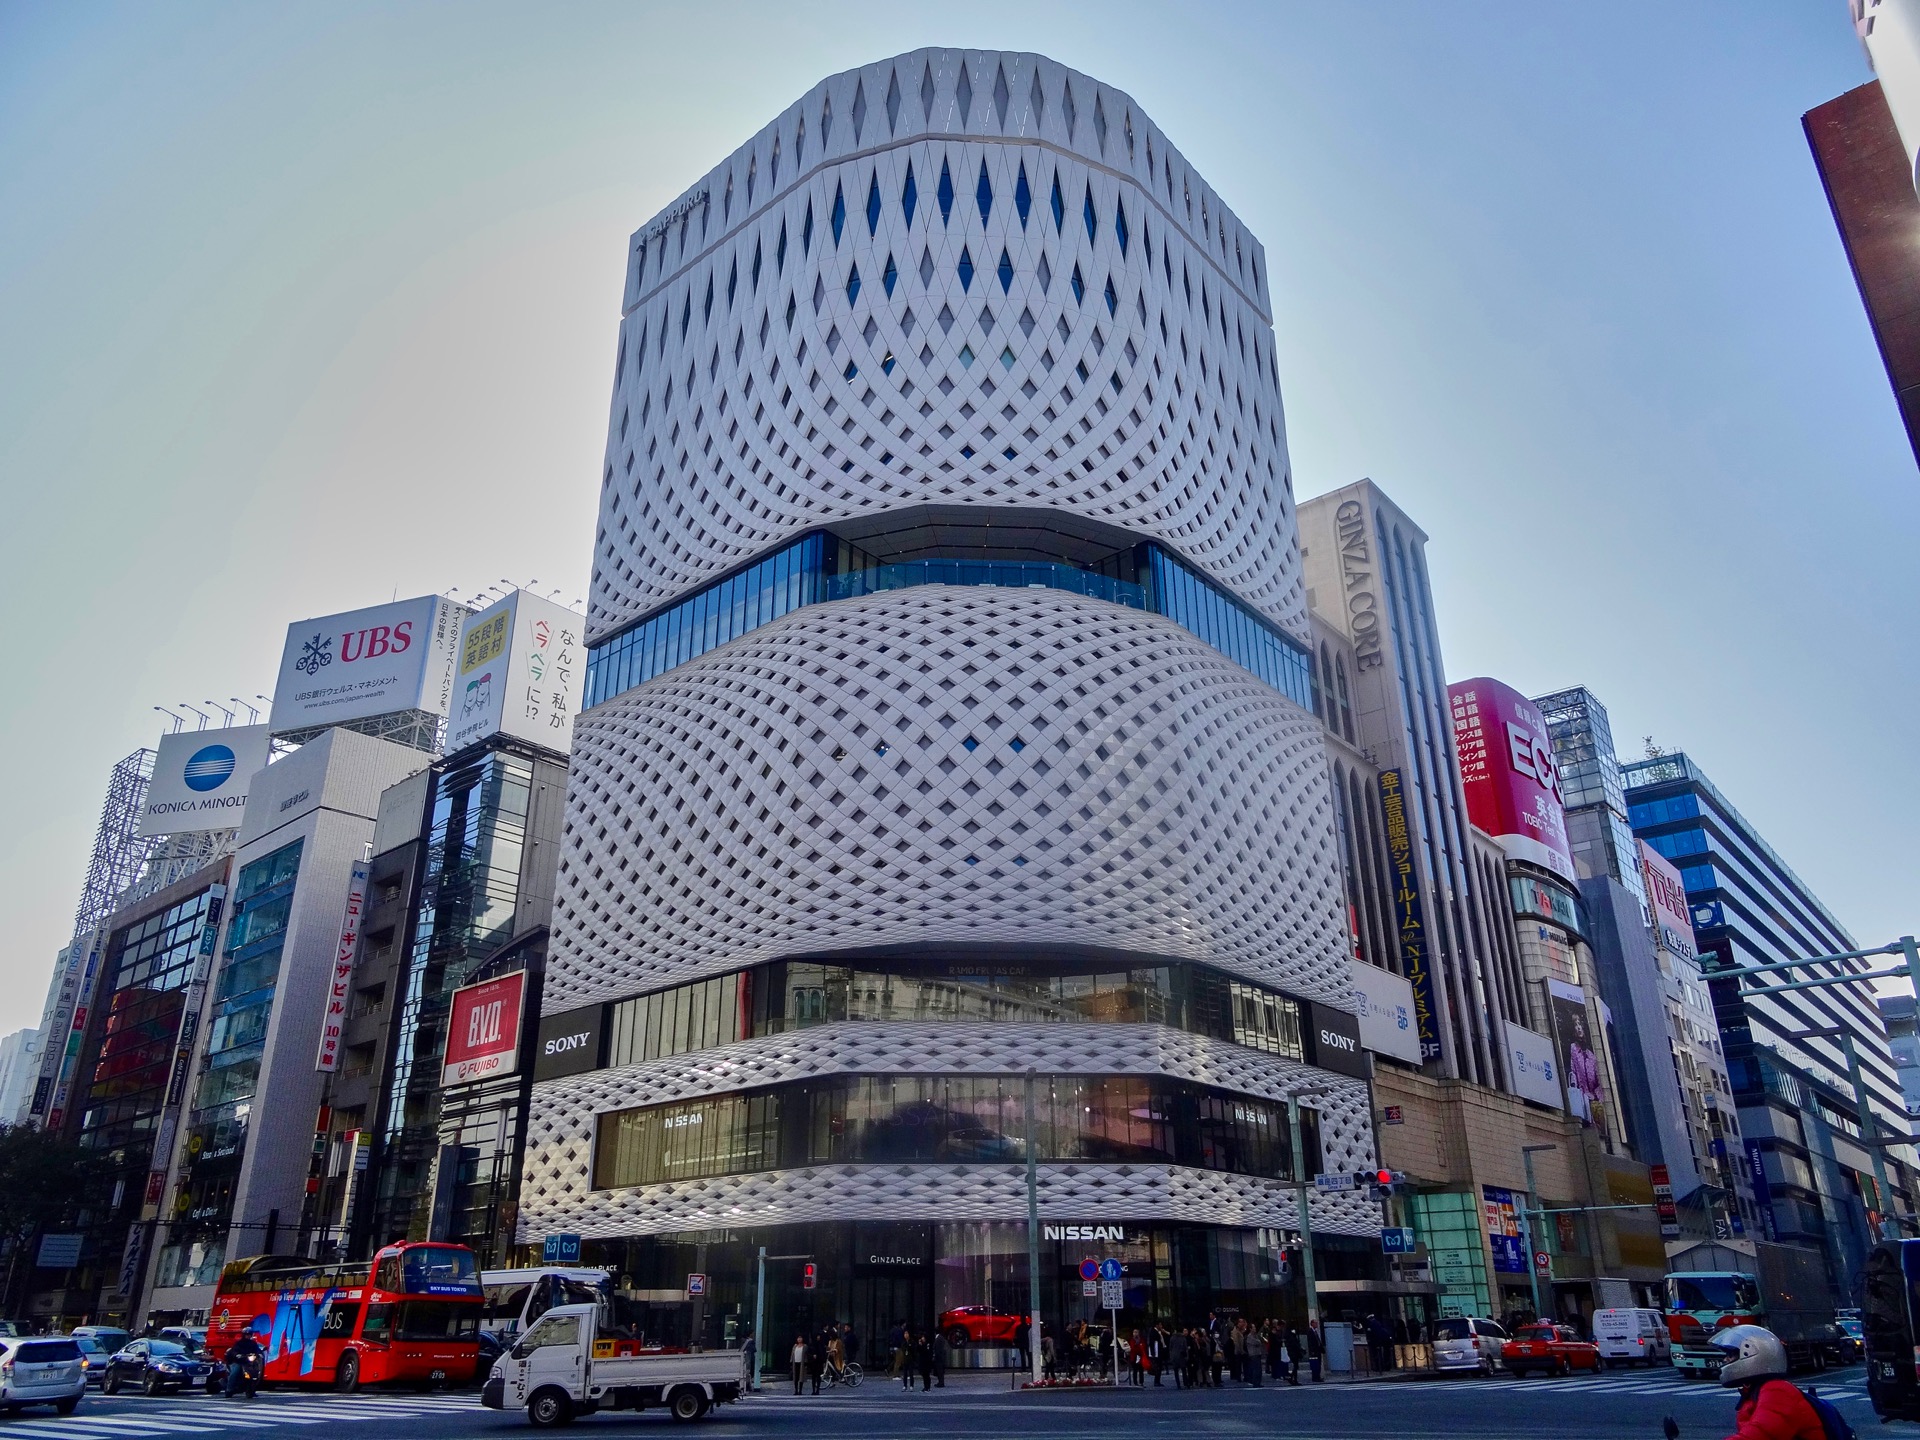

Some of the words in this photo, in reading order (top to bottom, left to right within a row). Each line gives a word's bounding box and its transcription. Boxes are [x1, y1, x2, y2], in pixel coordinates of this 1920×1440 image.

[1336, 500, 1370, 591] GINZA
[468, 615, 505, 650] 55段階
[1349, 591, 1383, 673] CORE
[340, 621, 413, 664] UBS
[465, 635, 503, 669] 英語村
[549, 628, 576, 730] なんで、私が
[1451, 690, 1476, 706] 会話
[1451, 703, 1478, 719] 国語
[1455, 715, 1480, 731] 国語
[1459, 761, 1485, 773] イツ語
[148, 801, 196, 815] KONICA
[199, 795, 248, 810] MINOLT
[1521, 811, 1543, 830] TOEIC
[203, 930, 213, 951] NOVA
[68, 941, 83, 972] SOTSU
[329, 892, 363, 1015] ニューギンザビル
[975, 966, 1008, 975] FRAS
[467, 1000, 502, 1048] B.V.D.
[545, 1031, 591, 1055] SONY
[1320, 1029, 1355, 1052] SONY
[467, 1057, 499, 1076] FUJIBO
[665, 1112, 703, 1129] NSSAN
[1235, 1107, 1267, 1125] NISSAN
[1752, 1148, 1762, 1175] MIZUNO
[1044, 1226, 1124, 1240] NISSAN
[870, 1254, 893, 1265] GINZA
[896, 1256, 921, 1265] PLACE
[269, 1293, 283, 1303] Tokyo
[283, 1292, 295, 1301] View
[323, 1311, 344, 1330] BUS
